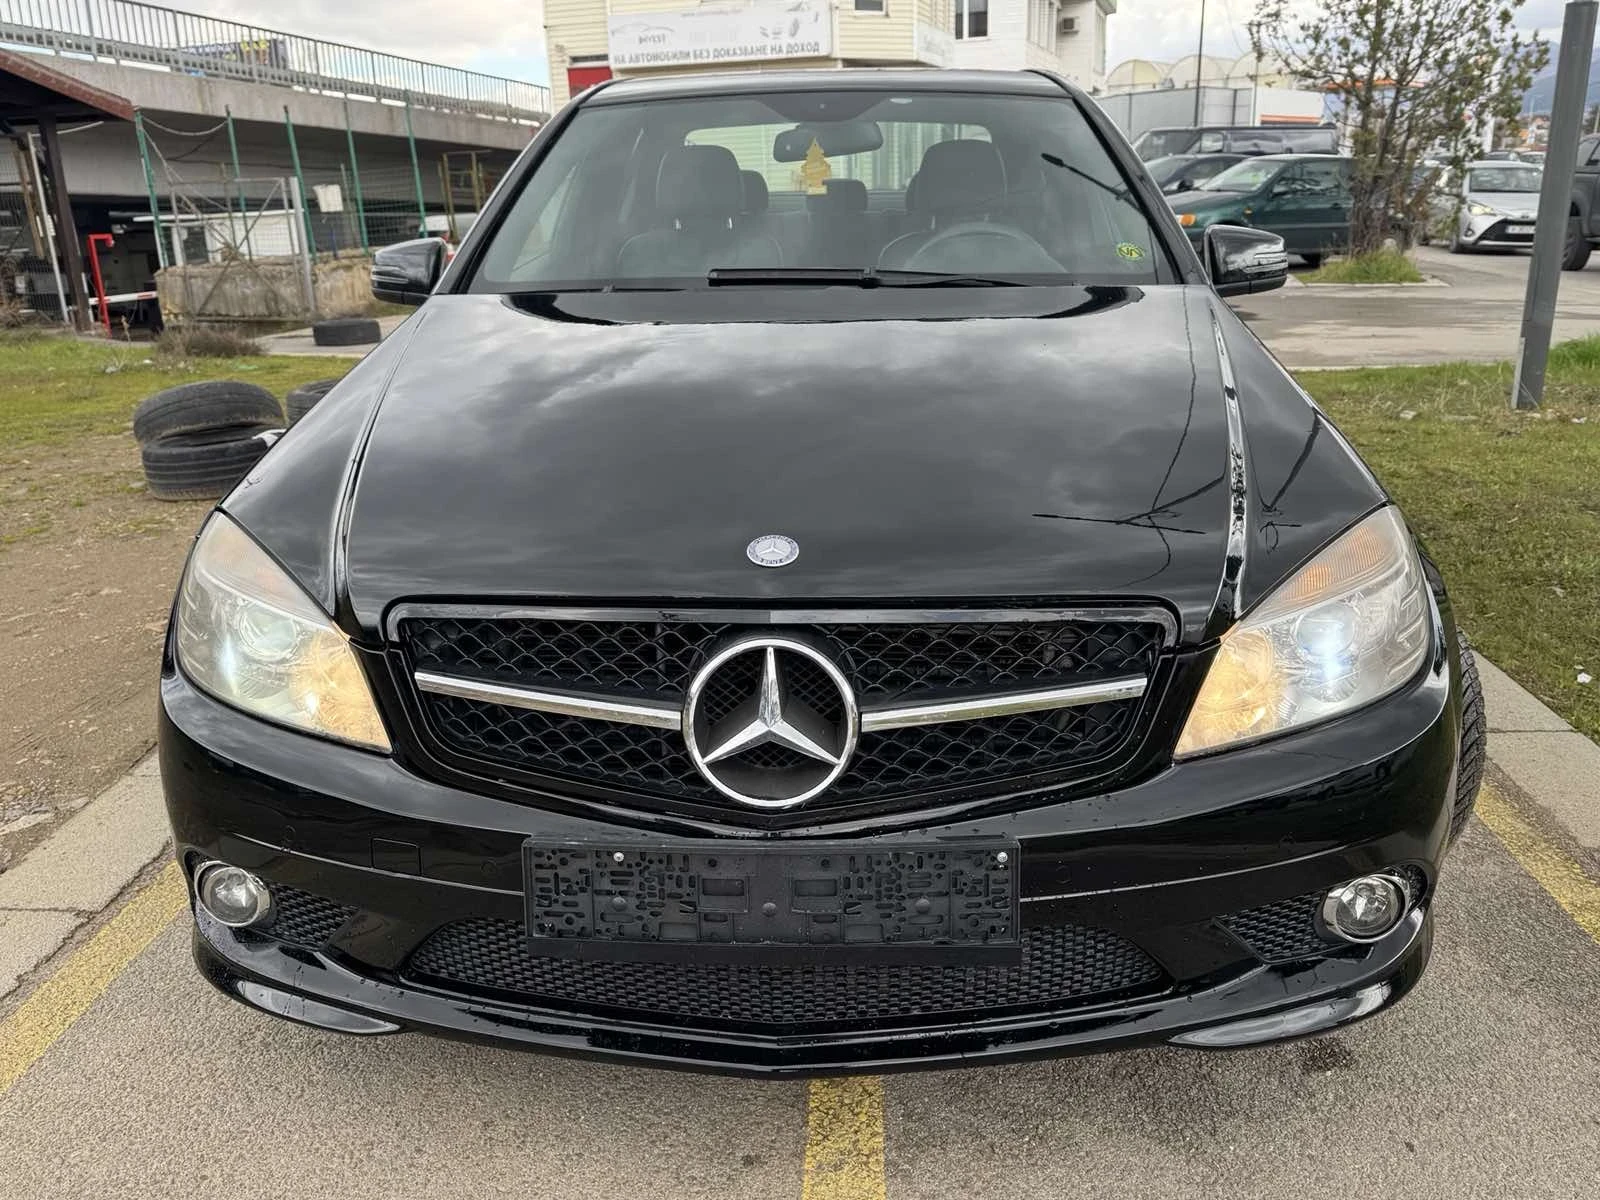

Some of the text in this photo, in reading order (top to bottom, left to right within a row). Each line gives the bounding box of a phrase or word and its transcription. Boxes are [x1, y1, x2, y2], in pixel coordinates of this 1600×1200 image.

[628, 51, 690, 64] АВТОМОБИЛИ
[693, 48, 710, 60] БЕЗ
[713, 45, 768, 59] ДОКАЗВАНЕ
[771, 43, 783, 55] НА
[786, 41, 819, 54] ДОХОД
